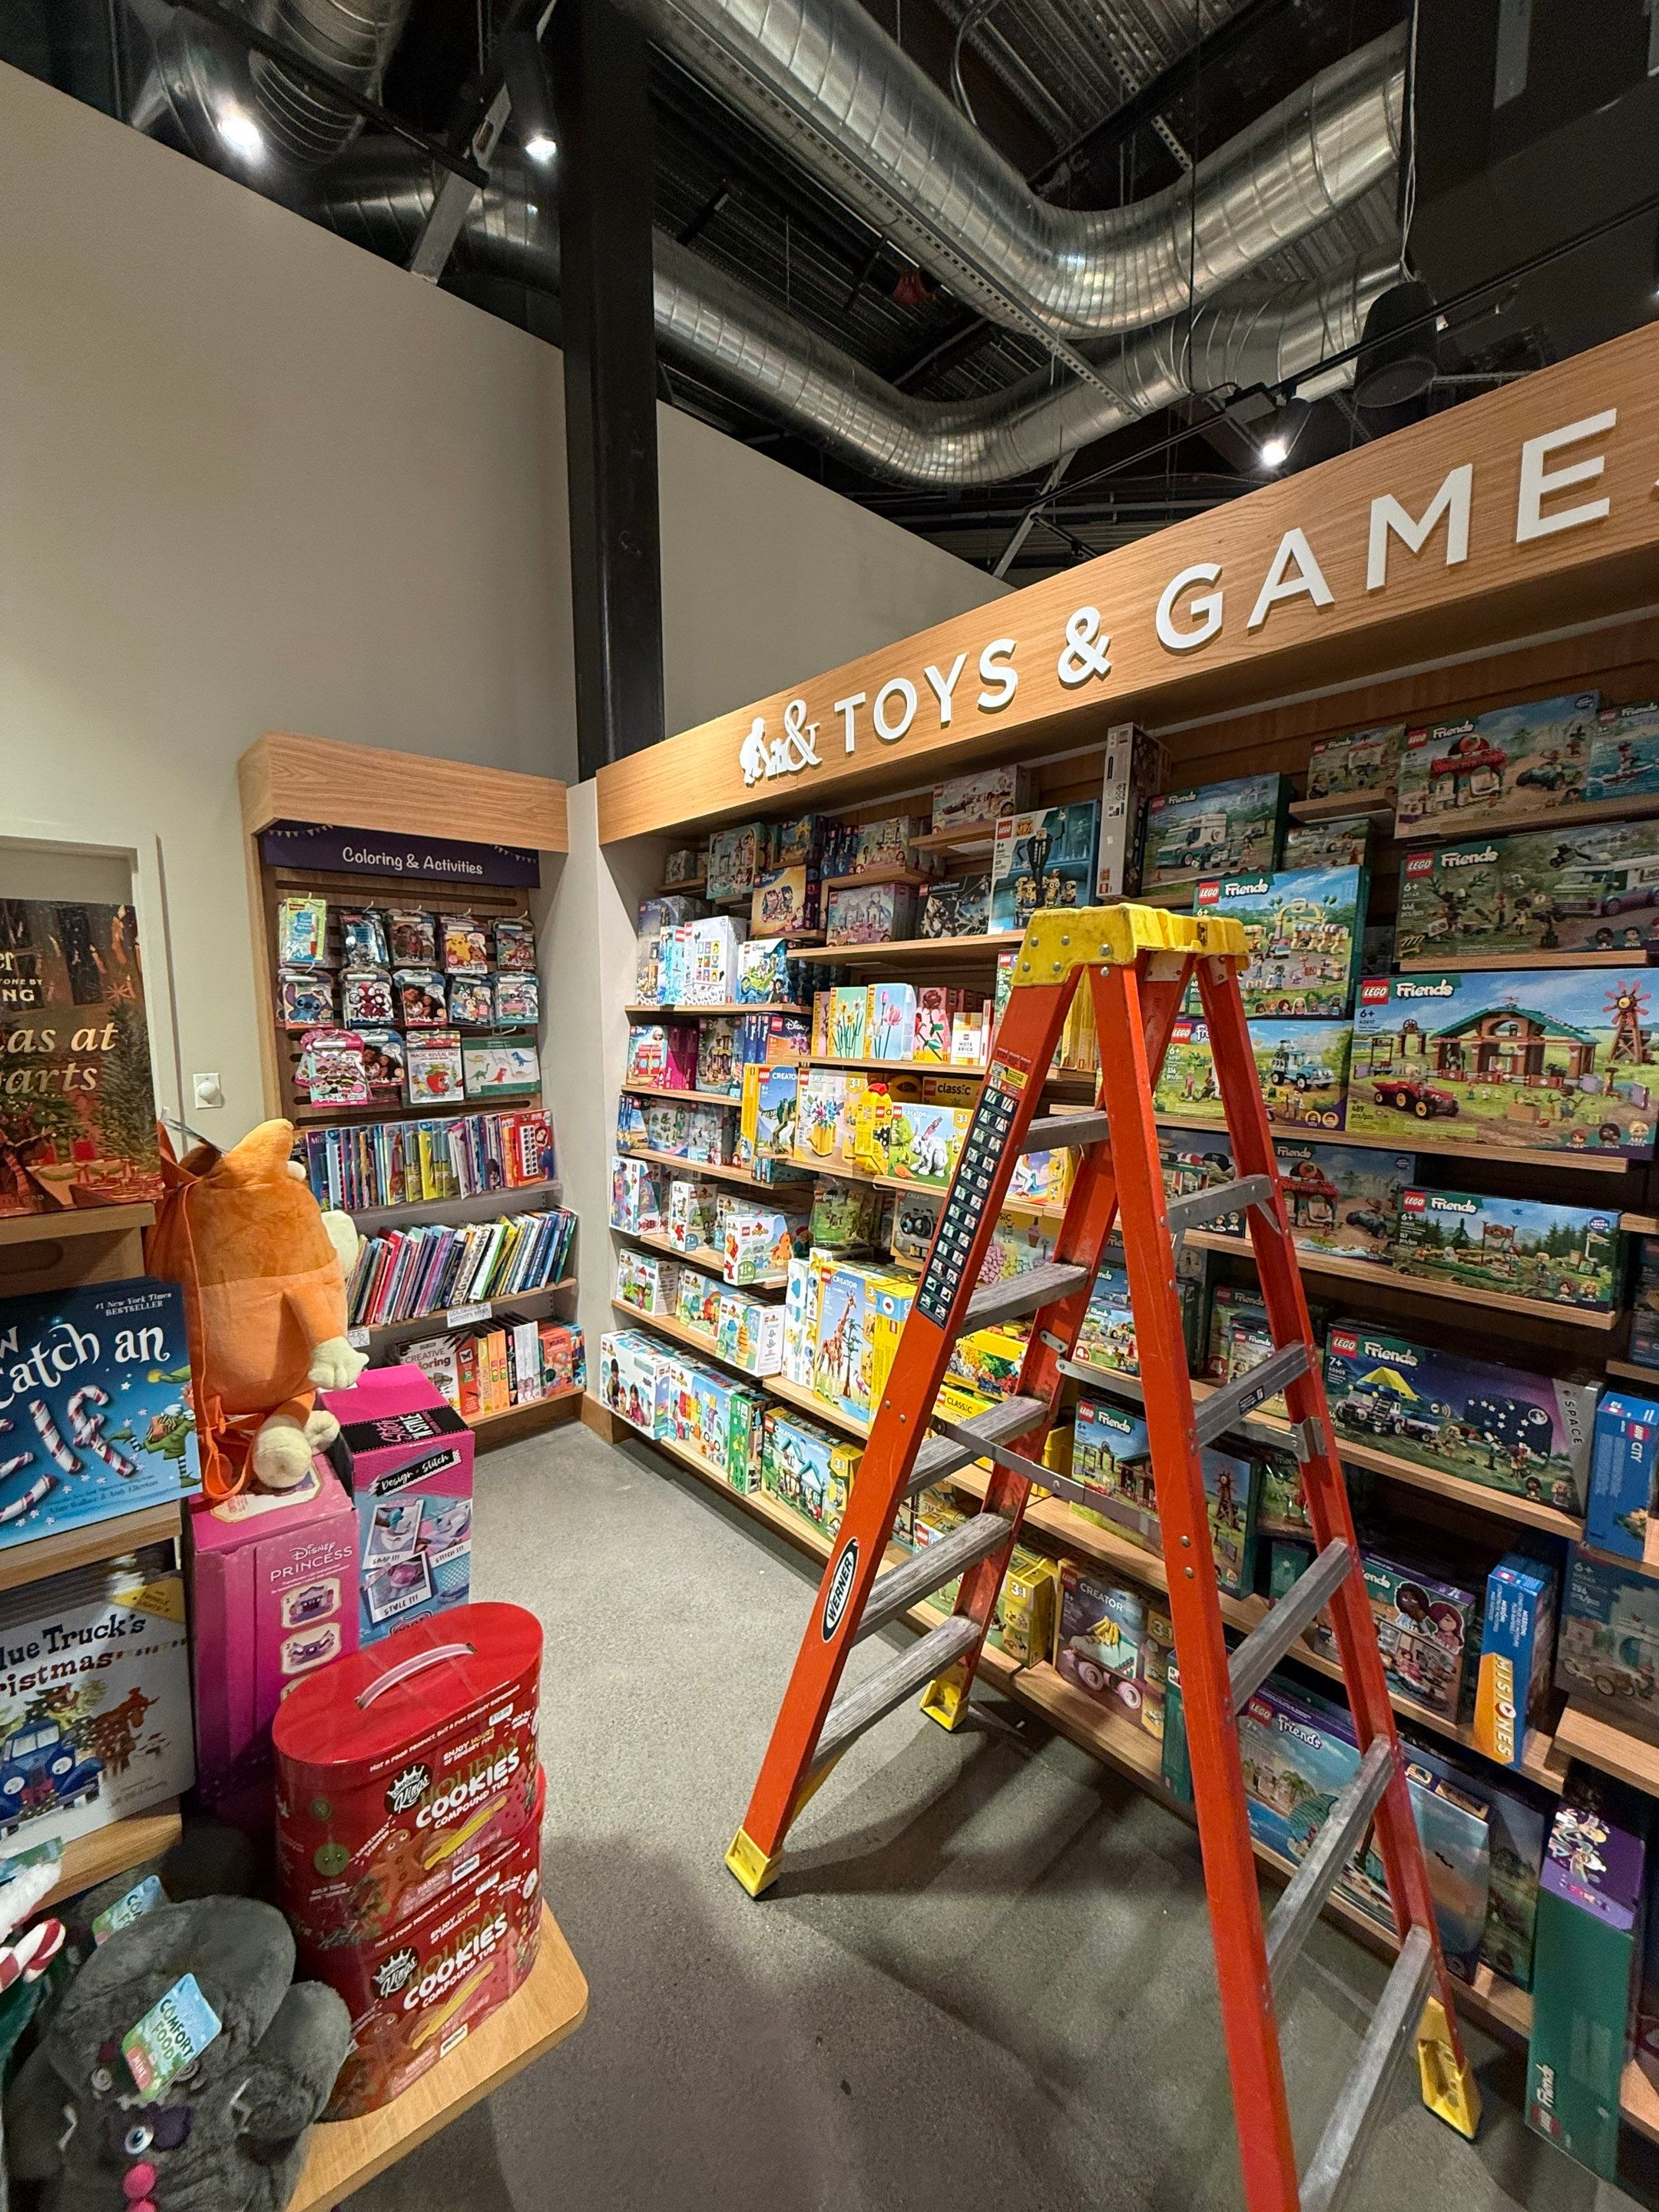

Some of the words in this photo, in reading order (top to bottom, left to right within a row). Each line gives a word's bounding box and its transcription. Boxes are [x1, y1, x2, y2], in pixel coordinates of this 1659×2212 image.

[833, 638, 1018, 753] TOYS
[1058, 605, 1111, 688] &
[1156, 408, 1659, 651] GAME
[1433, 720, 1474, 739] Friends
[1328, 739, 1352, 749] Friends
[1168, 791, 1197, 805] Friends
[343, 846, 402, 870] Coloring
[406, 853, 420, 869] &
[423, 855, 483, 875] Activities
[1408, 860, 1432, 870] LEGO
[1441, 846, 1498, 867] Friends
[1199, 887, 1219, 898] LEGO
[1224, 878, 1269, 896] Friends
[1404, 882, 1419, 891] 6+
[1197, 908, 1208, 916] 6+
[1363, 987, 1387, 997] LEGO
[1396, 979, 1454, 997] Friends
[1360, 1009, 1375, 1018] 6+
[785, 1018, 810, 1035] Disney
[0, 1027, 56, 1053] as
[71, 1022, 119, 1051] at
[2, 1063, 98, 1094] arts
[773, 1071, 797, 1081] CREATO
[810, 1074, 836, 1084] CREATOR
[938, 1084, 971, 1096] classic
[903, 1109, 928, 1118] CREATOR
[1277, 1145, 1313, 1160] Friends
[906, 1192, 929, 1202] CREATOR
[1405, 1197, 1426, 1207] LEGO
[1432, 1197, 1477, 1214] Friends
[832, 1275, 858, 1290] CREATOR
[95, 1301, 104, 1310] #1
[107, 1298, 123, 1308] New
[125, 1295, 146, 1306] York
[148, 1292, 171, 1302] Times
[105, 1300, 164, 1316] BESTSELLER
[1234, 1292, 1266, 1306] Friends
[1091, 1307, 1109, 1317] Friends
[114, 1326, 170, 1363] an
[1249, 1335, 1271, 1346] Friends
[404, 1347, 446, 1363] CREATIVE
[1329, 1357, 1343, 1366] 7+
[1333, 1338, 1356, 1349] LEGO
[1363, 1341, 1418, 1367] Friends
[419, 1356, 451, 1370] loring
[946, 1396, 973, 1415] CLASSIC
[1079, 1405, 1094, 1418] LEGO
[1098, 1411, 1131, 1435] Friends
[1564, 1399, 1584, 1445] SPACE
[1630, 1442, 1643, 1463] CITY
[381, 1471, 413, 1490] Design
[422, 1453, 449, 1472] Stitch
[290, 1541, 336, 1561] Disney
[435, 1548, 455, 1564] STITCH
[270, 1545, 353, 1582] PRINCESS
[1575, 1561, 1594, 1574] 6+
[828, 1557, 853, 1622] WERNER
[1080, 1583, 1124, 1612] CREATOR
[384, 1600, 406, 1616] STYLE
[0, 1641, 41, 1671] lue
[43, 1613, 146, 1653] Truck's
[0, 1651, 114, 1698] ristmas
[1250, 1703, 1272, 1720] LEGO
[1278, 1713, 1323, 1750] friends
[391, 1750, 408, 1763] FOOD
[443, 1741, 469, 1761] ENJOY
[393, 1773, 432, 1813] Kings
[416, 1748, 520, 1828] COOKIES
[434, 1786, 490, 1830] COMPOUND
[491, 1776, 508, 1793] TUB
[404, 1912, 508, 2011] COOKIES
[422, 1960, 476, 2008] COMPOUND
[478, 1942, 496, 1962] TUB
[159, 1998, 195, 2058] COMFORT
[152, 2020, 175, 2061] FOOD
[1536, 2064, 1555, 2108] Friends
